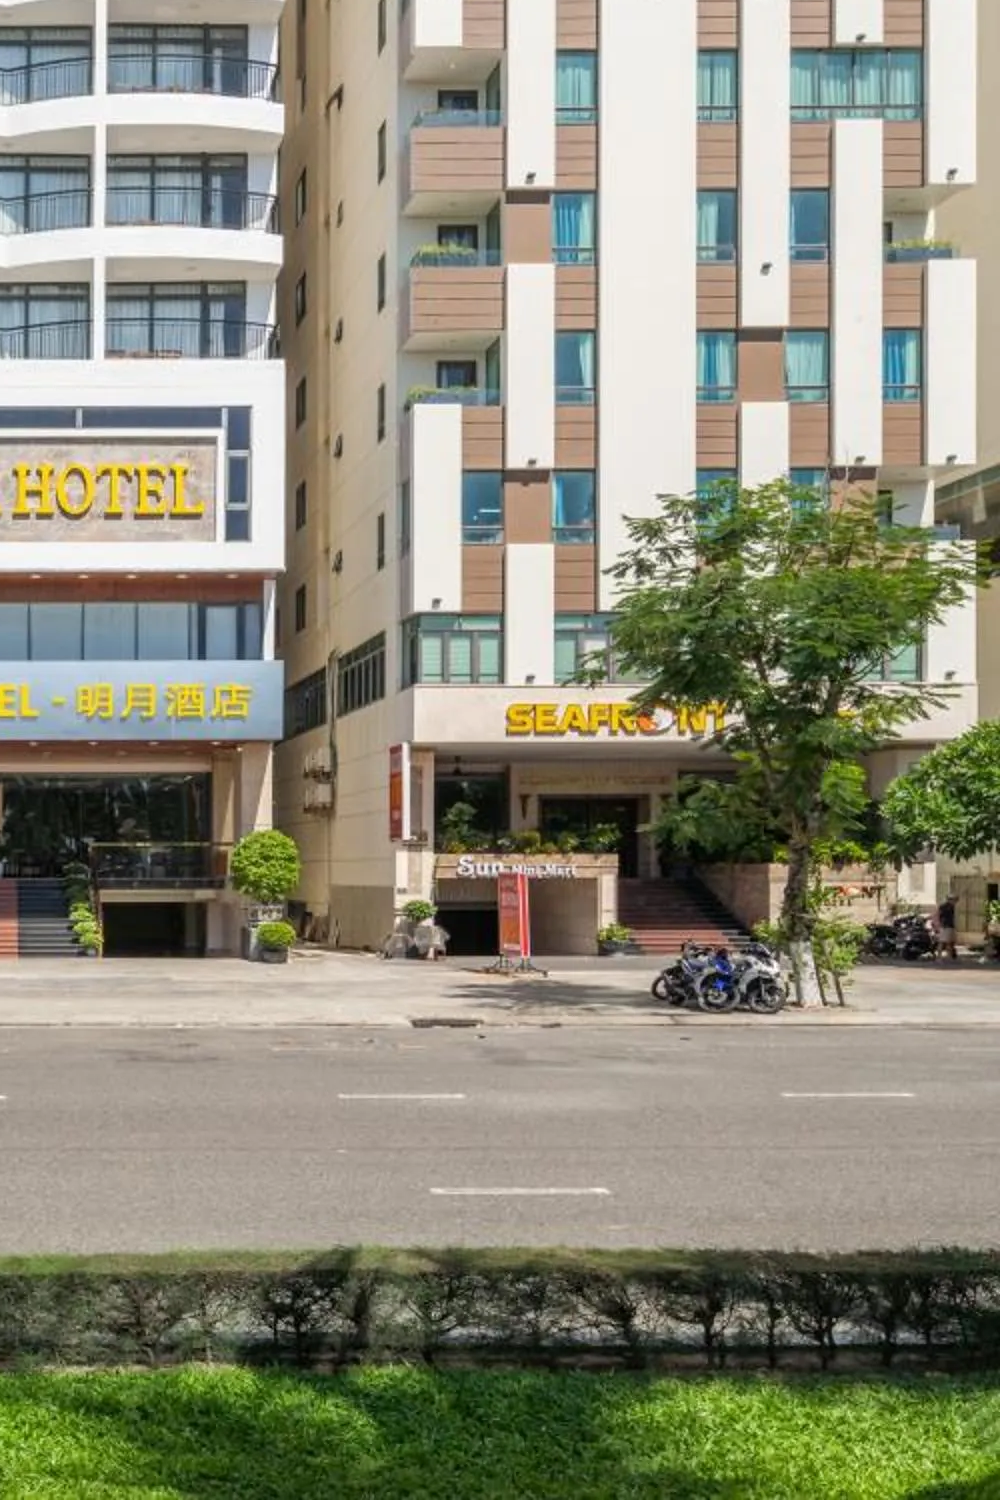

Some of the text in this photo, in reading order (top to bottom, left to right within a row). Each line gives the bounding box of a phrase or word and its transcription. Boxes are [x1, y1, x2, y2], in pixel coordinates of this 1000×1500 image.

[12, 462, 205, 518] HOTEL
[75, 683, 252, 721] 明月酒店
[457, 855, 504, 877] Sun
